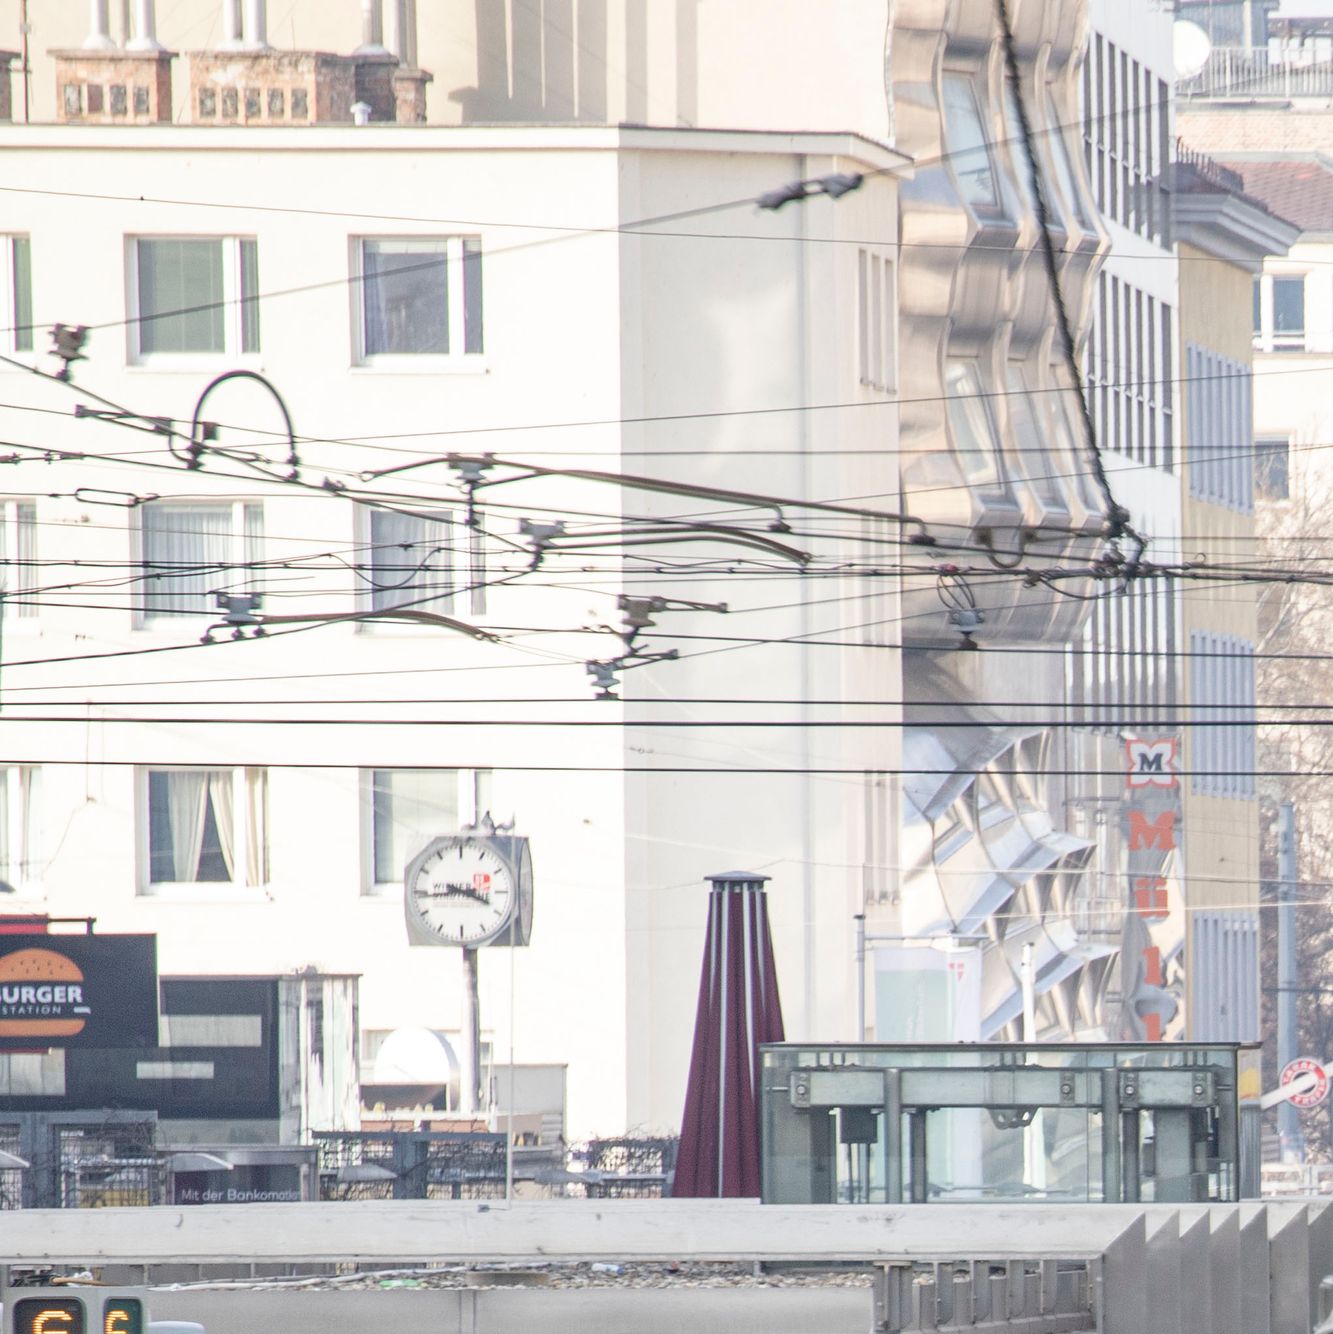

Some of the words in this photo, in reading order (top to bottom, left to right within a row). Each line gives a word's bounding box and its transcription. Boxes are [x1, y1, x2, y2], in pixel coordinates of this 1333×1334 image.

[0, 985, 82, 1003] URGER
[2, 1006, 61, 1015] STATION
[201, 1187, 224, 1201] der
